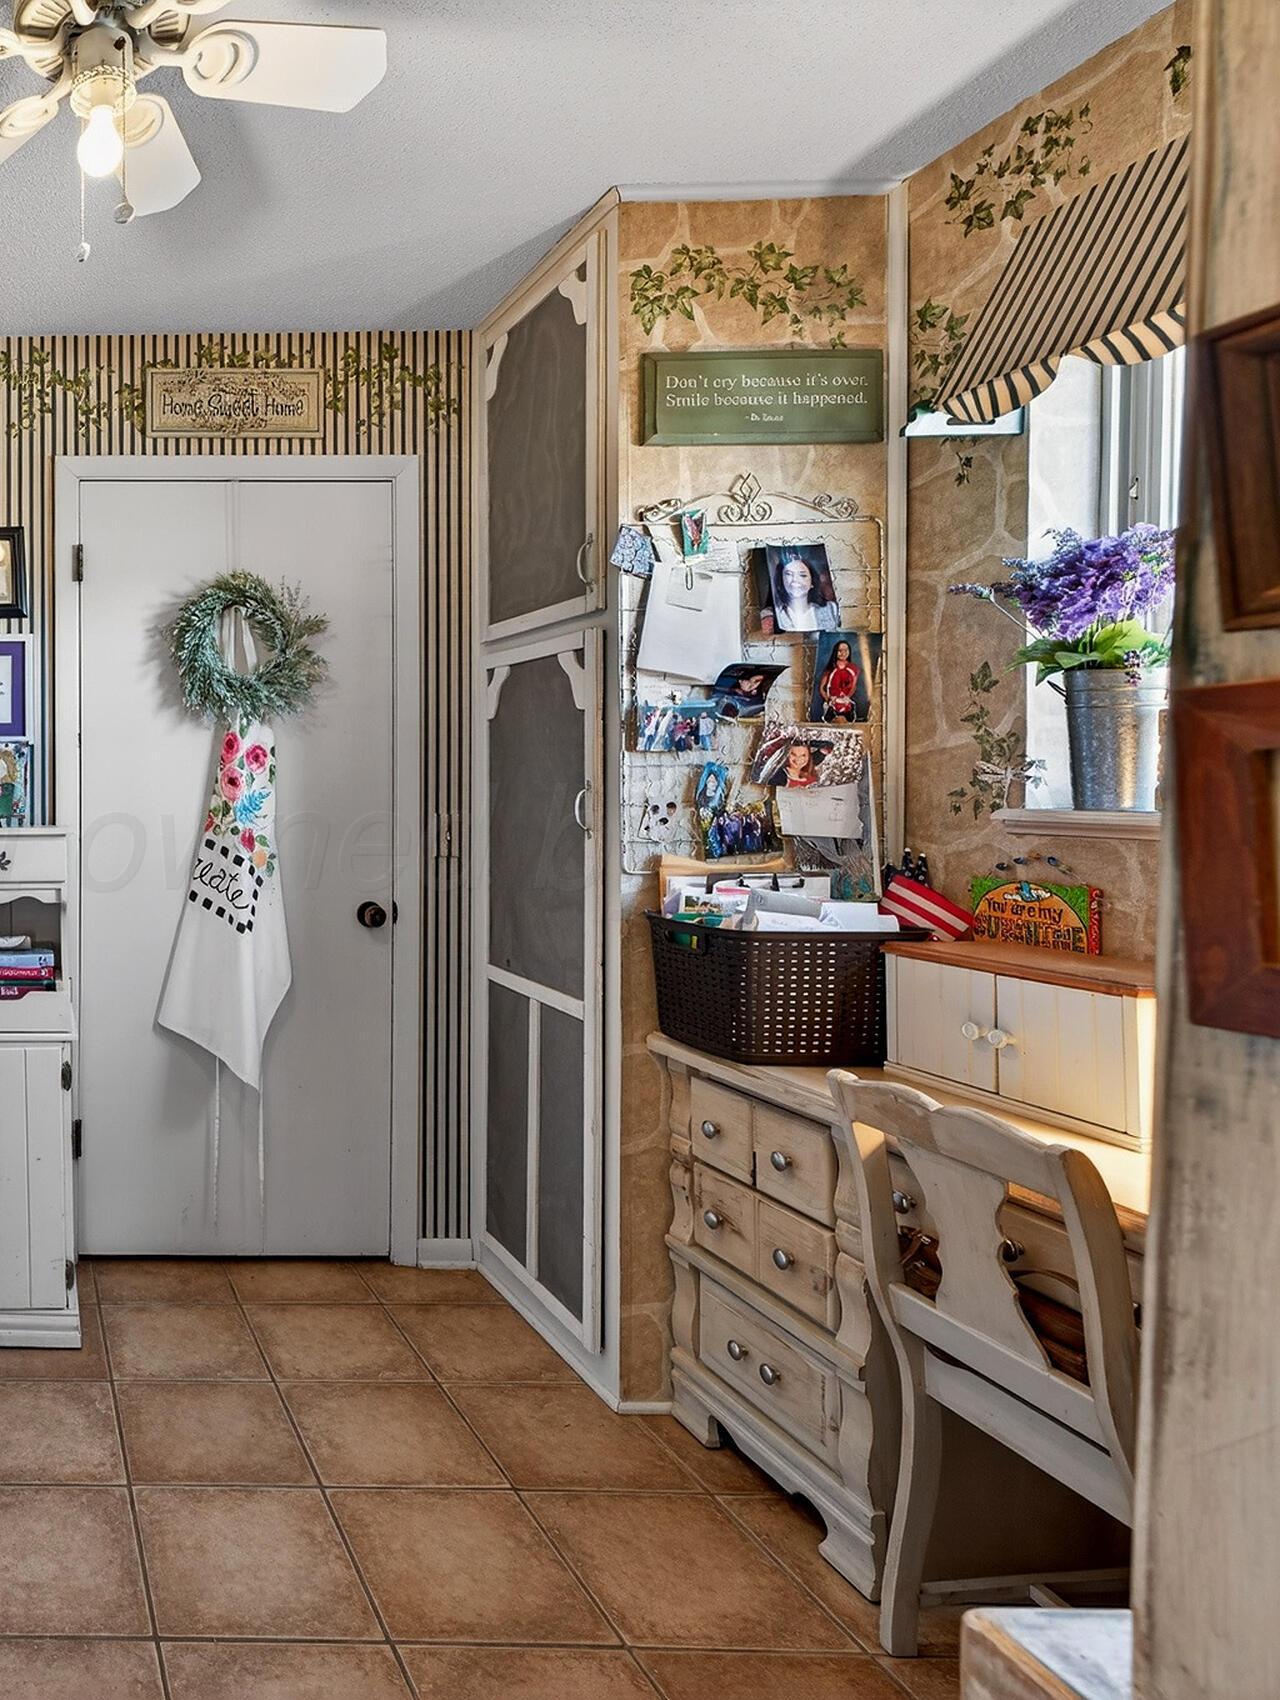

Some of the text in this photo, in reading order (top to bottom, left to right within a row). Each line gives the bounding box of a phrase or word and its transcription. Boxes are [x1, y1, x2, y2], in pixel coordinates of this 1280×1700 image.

[666, 373, 869, 391] Don't cry because it's over.
[162, 394, 304, 416] Home Sweet Home
[666, 391, 869, 407] Smile because it happened.
[193, 858, 250, 909] reate
[984, 896, 1063, 925] You are my
